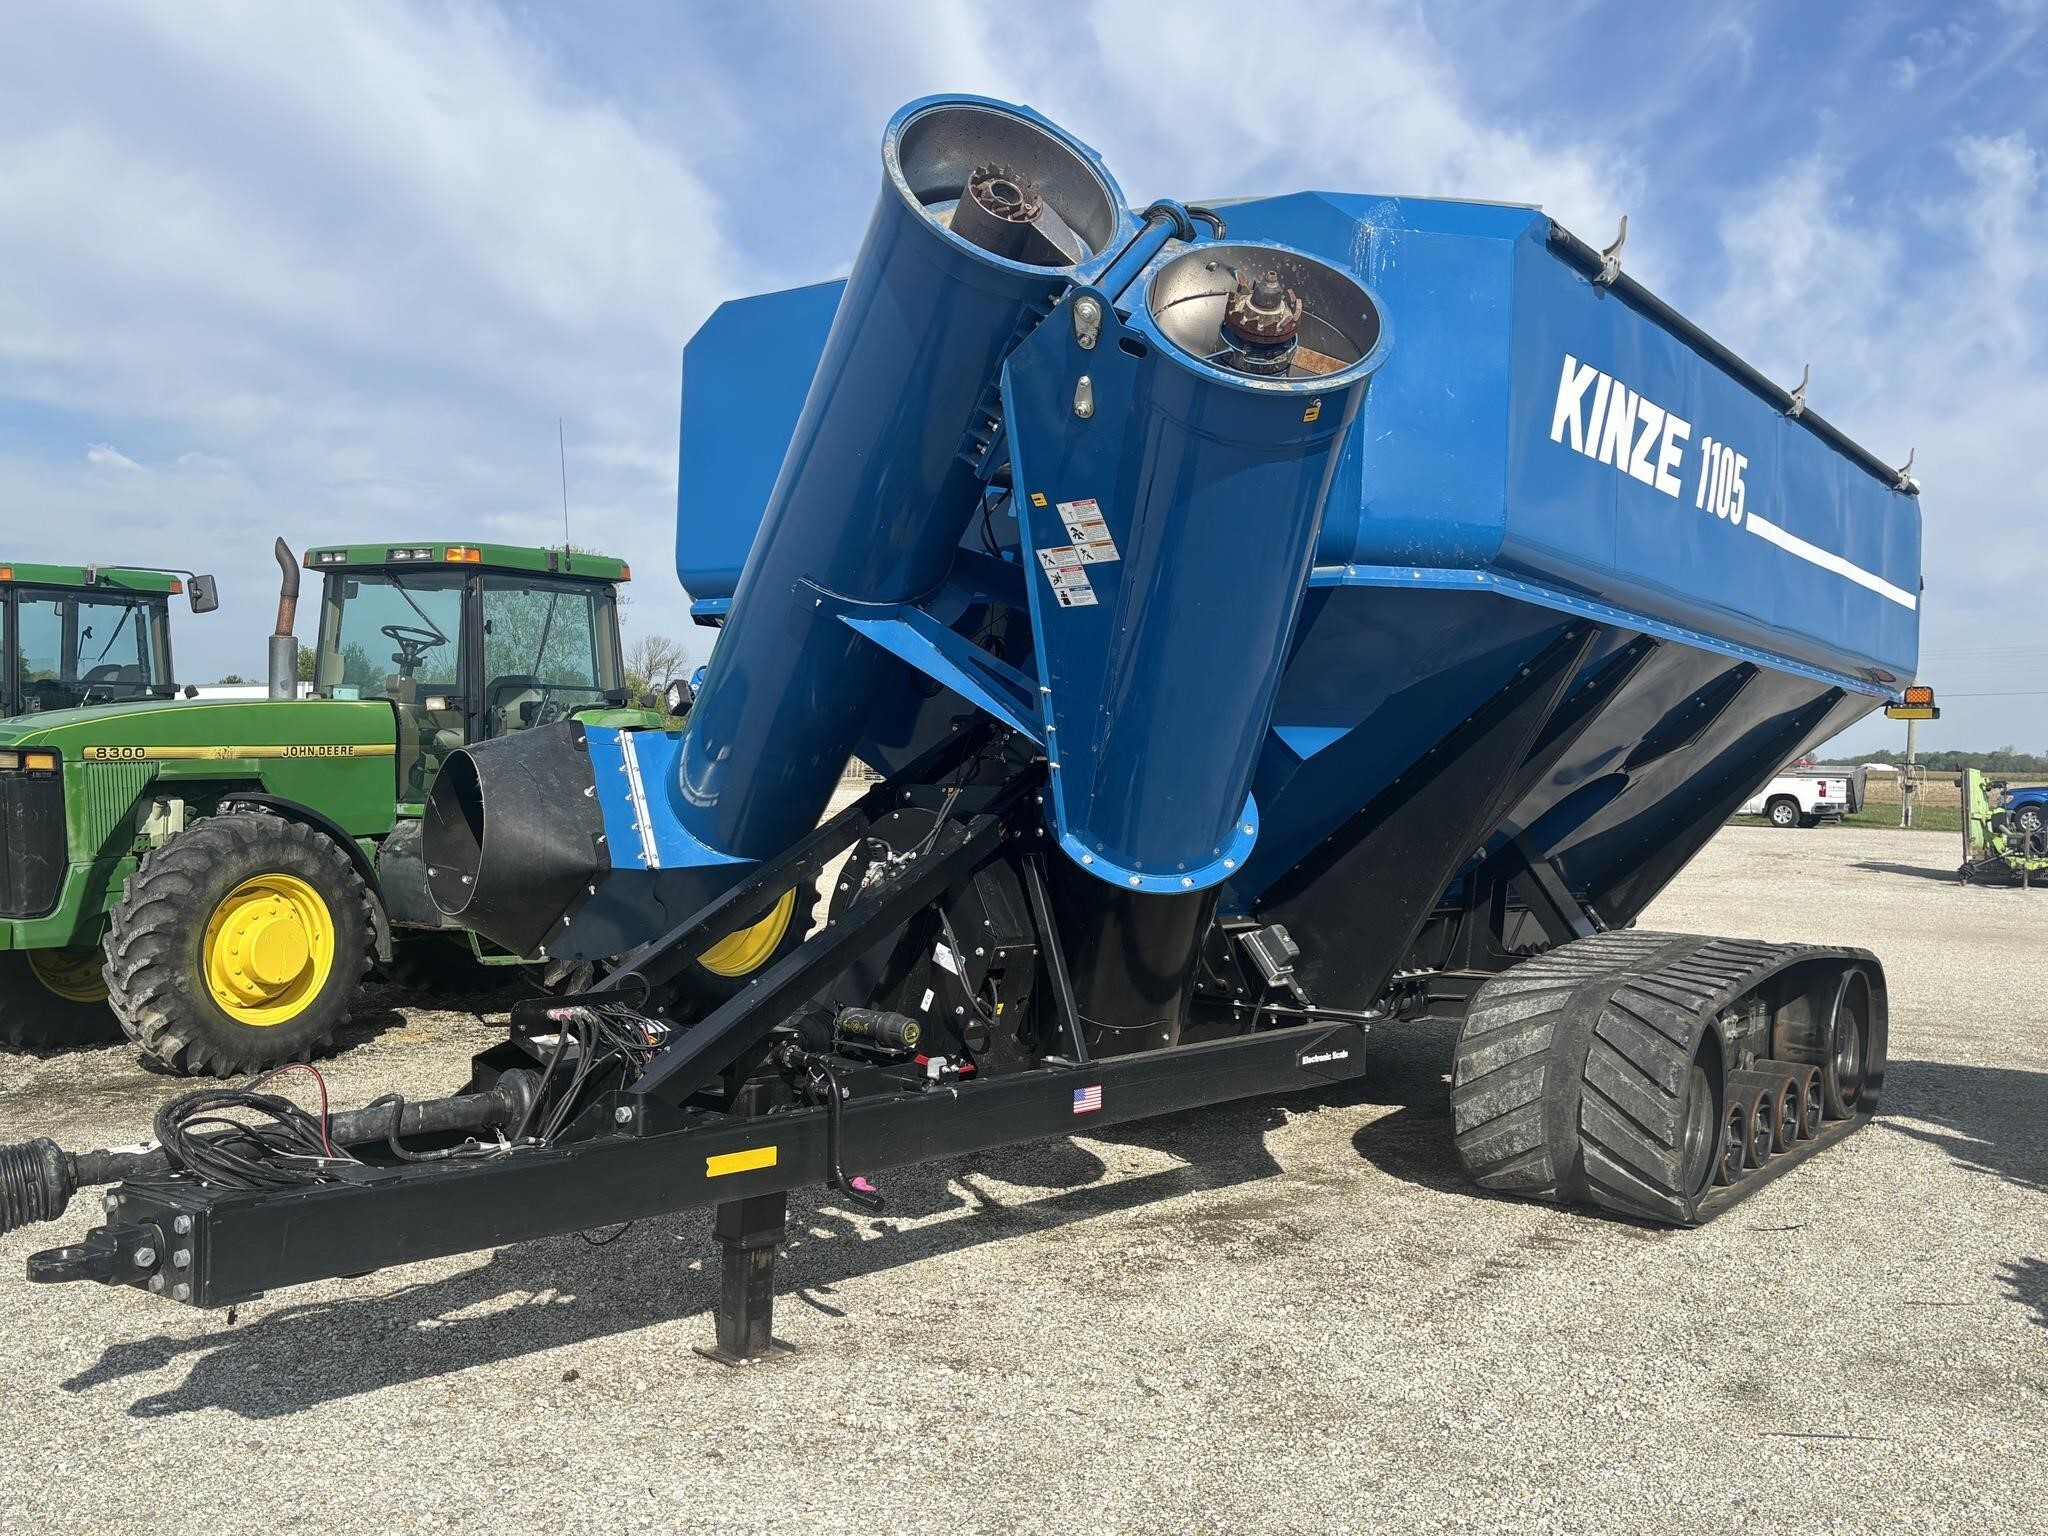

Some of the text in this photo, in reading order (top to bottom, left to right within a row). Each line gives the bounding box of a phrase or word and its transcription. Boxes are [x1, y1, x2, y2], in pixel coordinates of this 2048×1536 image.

[1550, 352, 1749, 526] KINZE 1105
[96, 746, 146, 759] 8300
[282, 746, 355, 757] JOHN DEERE
[1302, 1050, 1349, 1065] Electronic Scale
